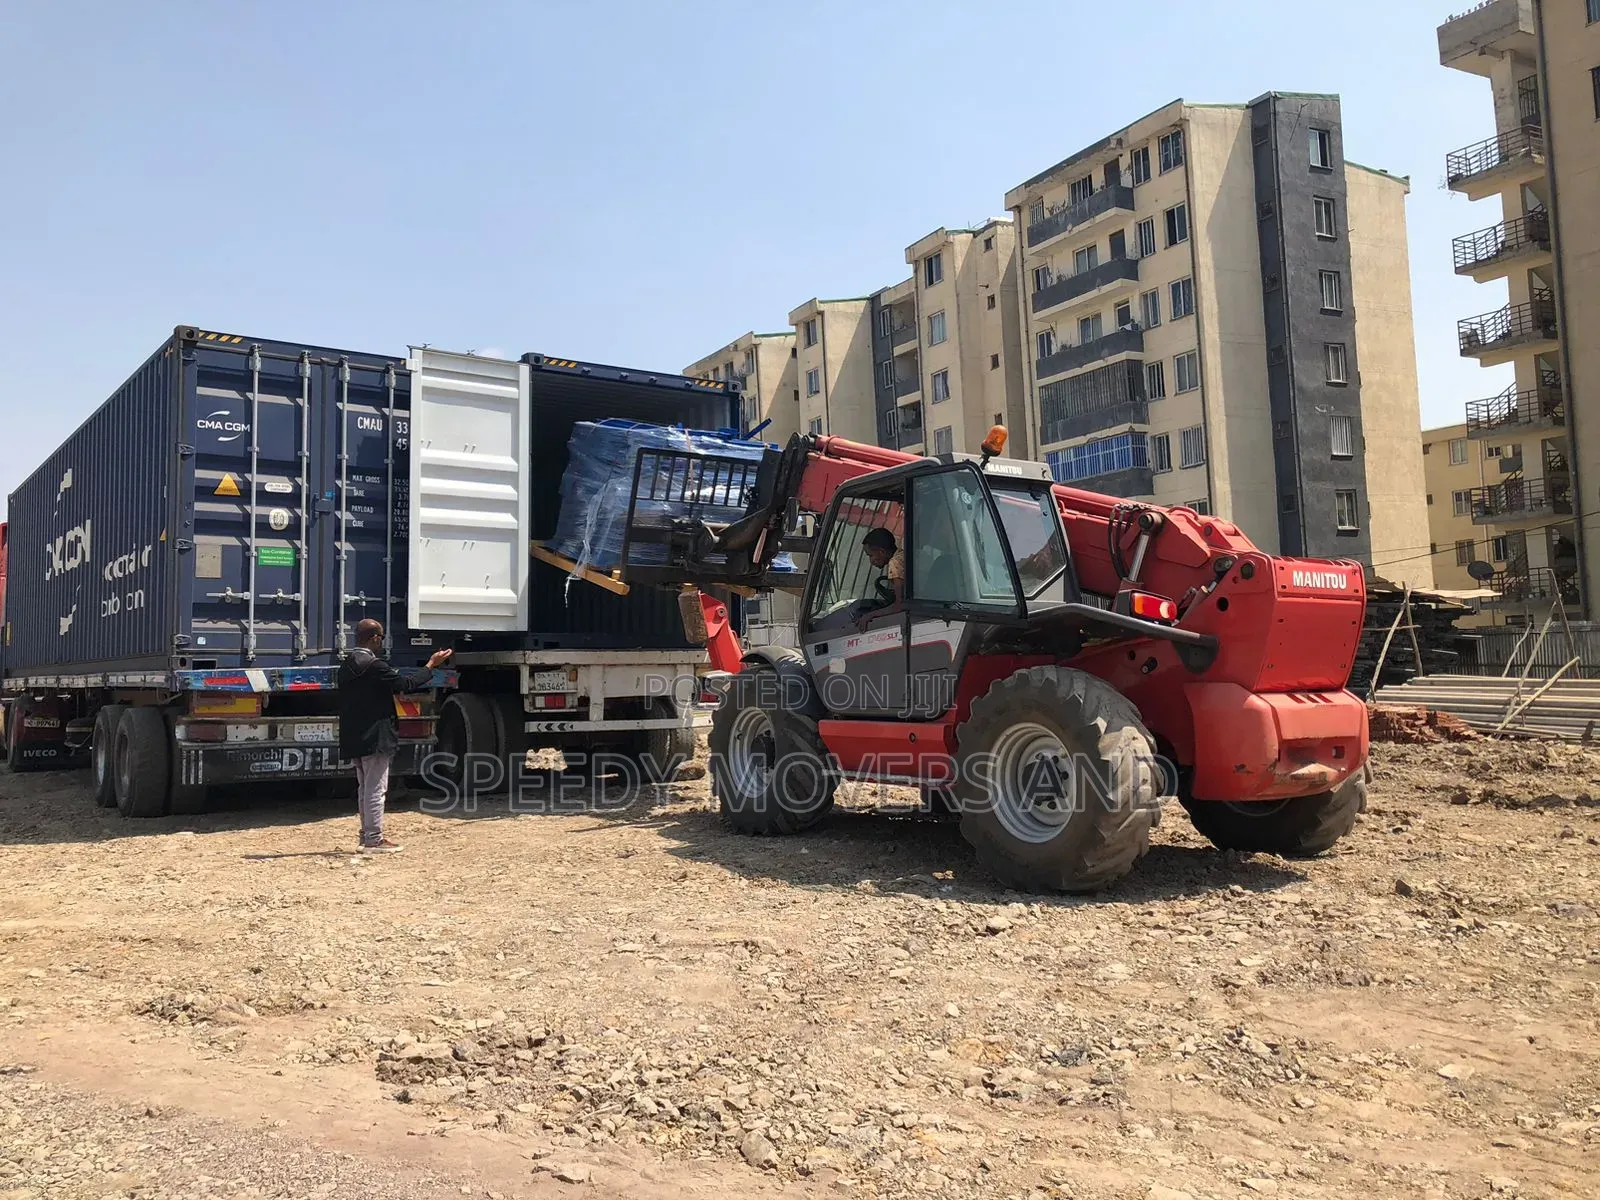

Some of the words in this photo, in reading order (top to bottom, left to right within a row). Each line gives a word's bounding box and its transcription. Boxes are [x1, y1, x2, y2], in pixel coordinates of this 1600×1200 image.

[196, 419, 223, 430] CMA
[224, 422, 250, 432] CGM
[357, 416, 383, 431] CMAU
[987, 462, 1023, 475] MANITOU
[1293, 570, 1347, 590] MANITOU
[23, 749, 58, 758] IVECO
